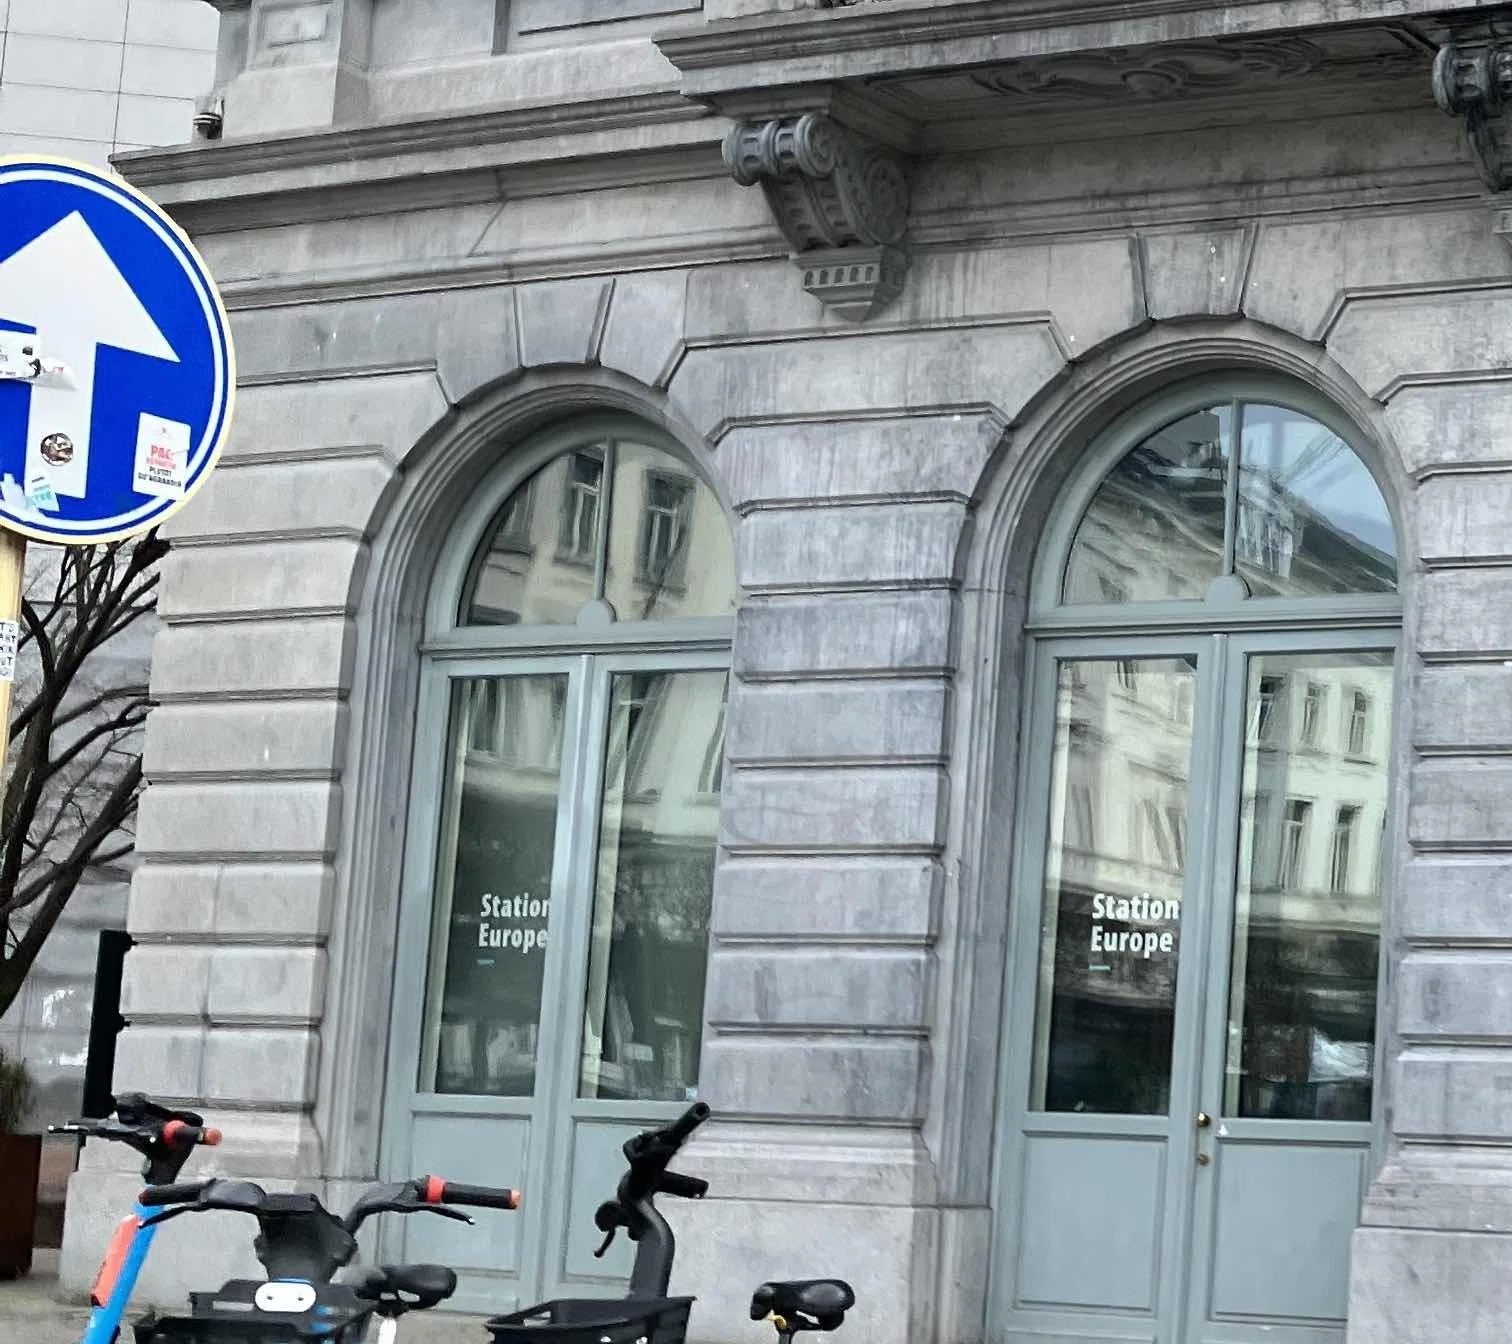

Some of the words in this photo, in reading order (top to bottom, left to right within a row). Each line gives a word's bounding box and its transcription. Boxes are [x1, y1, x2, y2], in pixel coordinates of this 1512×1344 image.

[1091, 892, 1180, 920] Station
[478, 923, 548, 953] Europe
[1091, 926, 1173, 959] Europe
